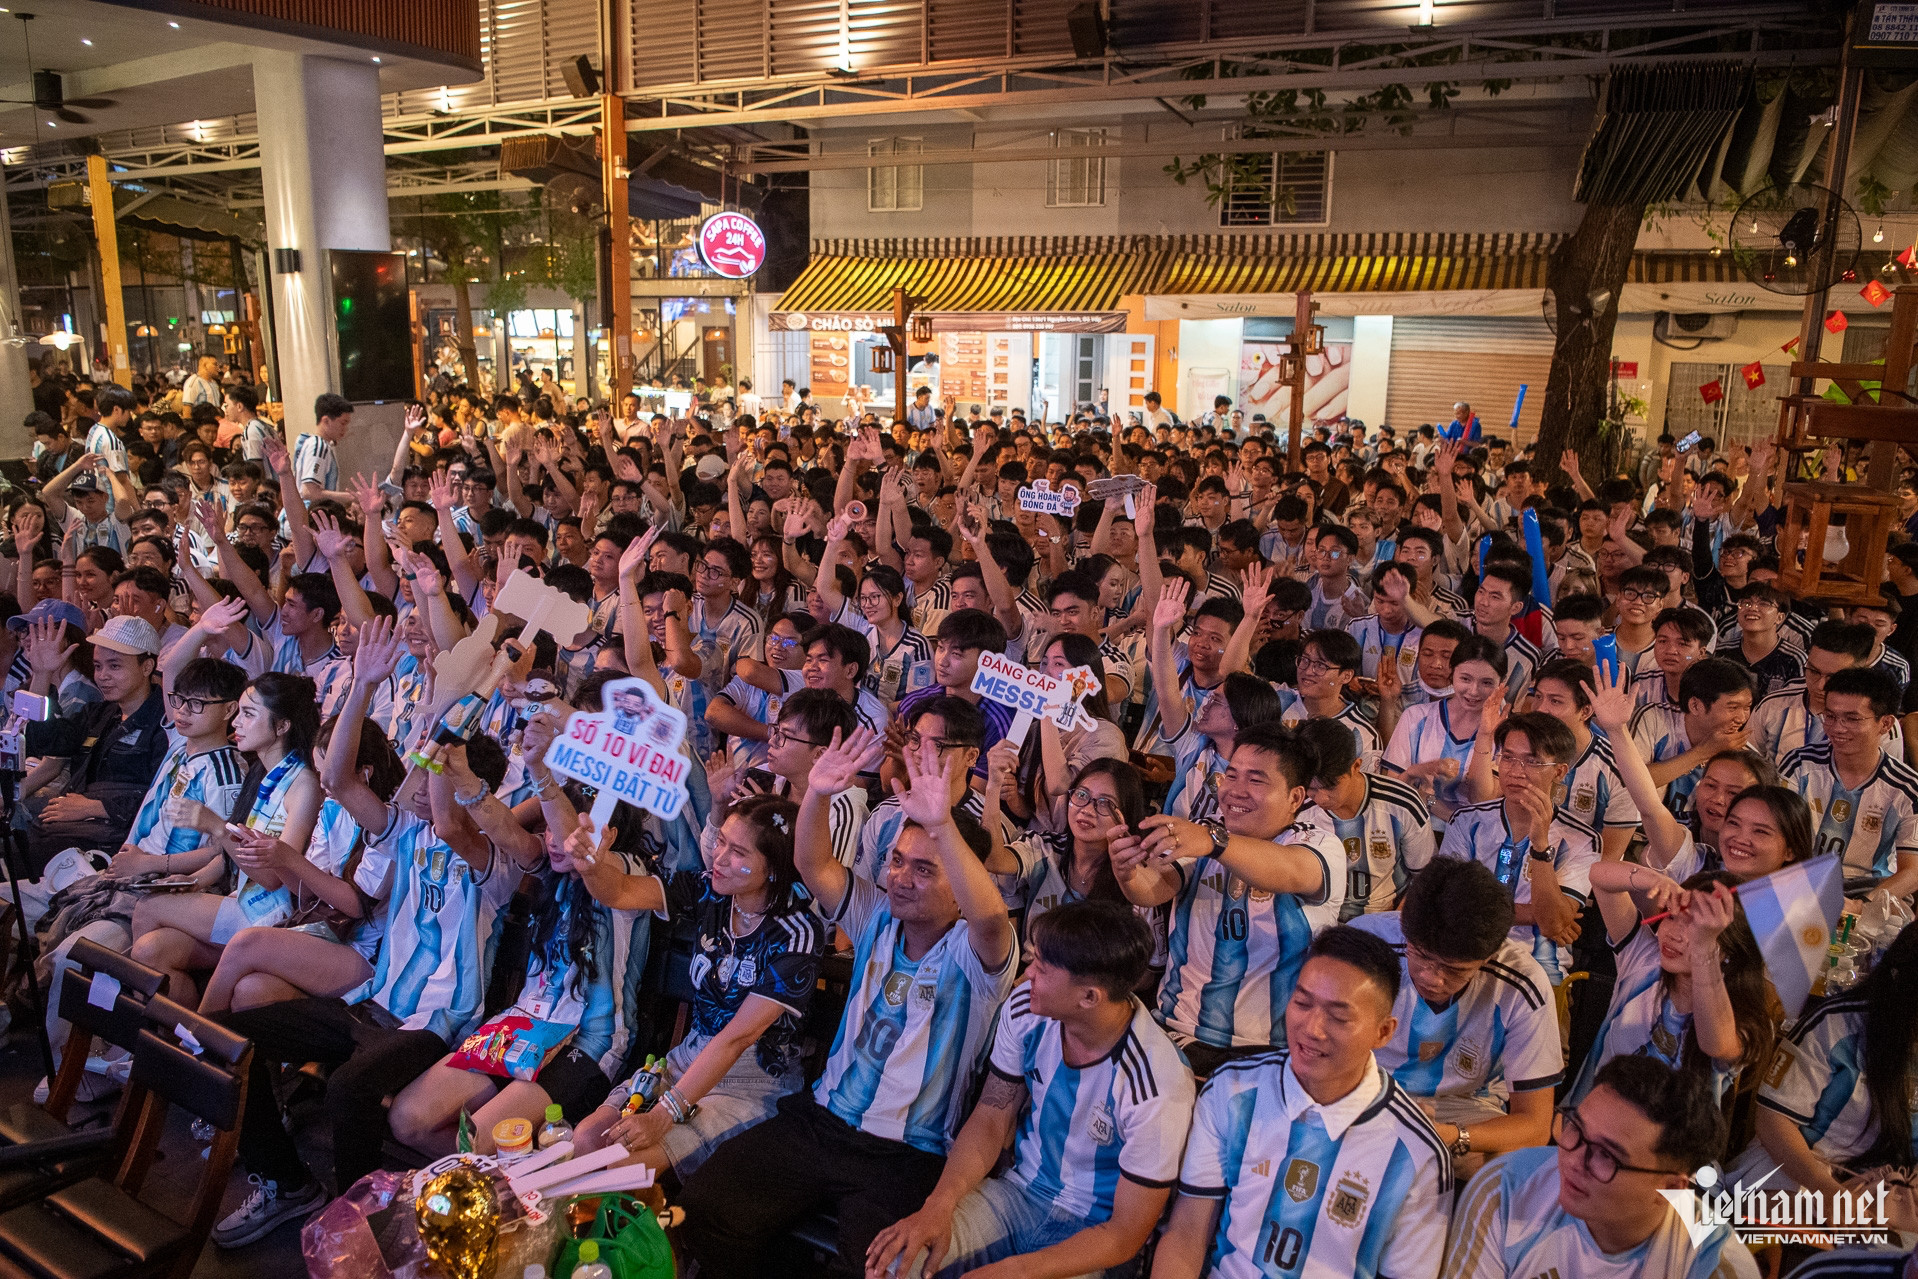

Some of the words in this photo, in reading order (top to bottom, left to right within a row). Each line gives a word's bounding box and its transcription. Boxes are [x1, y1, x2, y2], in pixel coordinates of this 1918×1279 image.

[706, 218, 730, 243] SAPA
[731, 217, 763, 249] COFFEE
[725, 231, 745, 247] 24H
[1706, 292, 1756, 304] Salon
[1216, 302, 1257, 312] Salon
[811, 315, 852, 331] CHÁO
[854, 315, 874, 331] SÒ
[1020, 488, 1036, 500] ÔNG
[1046, 500, 1057, 511] ĐÁ
[974, 672, 1048, 715] MESSI
[527, 704, 539, 713] 10
[571, 718, 604, 745] SỐ
[602, 733, 626, 758] 10
[649, 752, 683, 785] ĐẠI
[552, 743, 612, 786] MESSI
[612, 768, 651, 802] BẤT
[421, 881, 442, 913] 10
[1222, 908, 1248, 941] 10
[919, 986, 935, 1001] AFA
[1291, 1184, 1307, 1195] FIFA
[1336, 1192, 1358, 1216] AFA
[1263, 1220, 1303, 1272] 10
